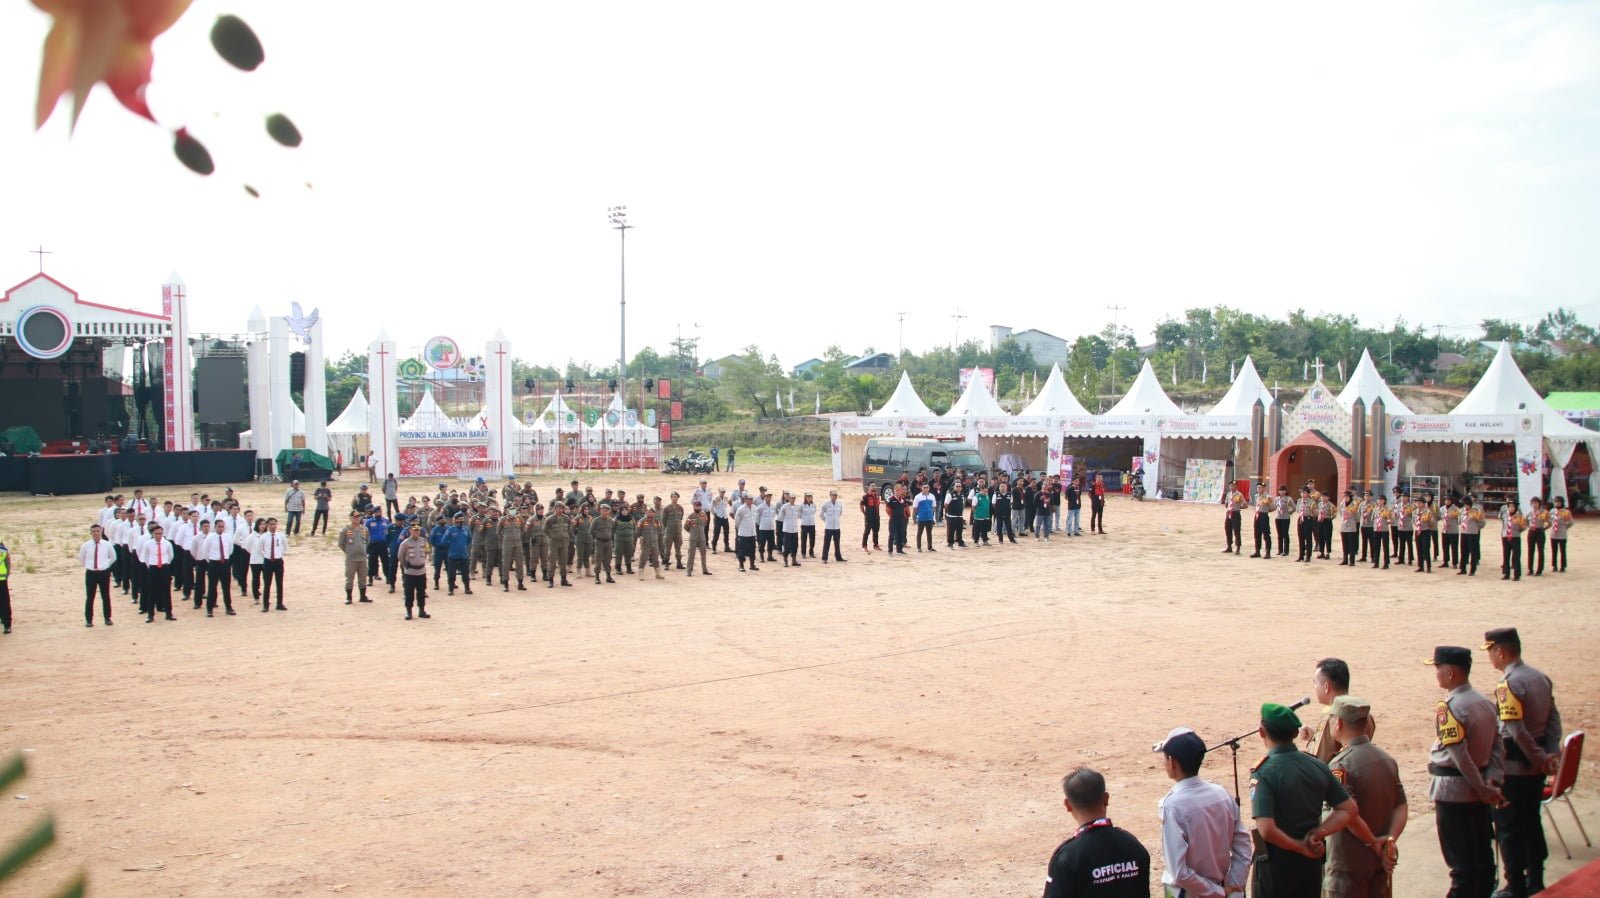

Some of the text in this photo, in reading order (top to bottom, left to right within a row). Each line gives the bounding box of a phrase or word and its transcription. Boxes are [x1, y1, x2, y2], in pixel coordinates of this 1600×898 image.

[399, 431, 426, 439] PROVINSI
[468, 430, 488, 438] BARAT
[1092, 860, 1139, 879] OFFICIAL
